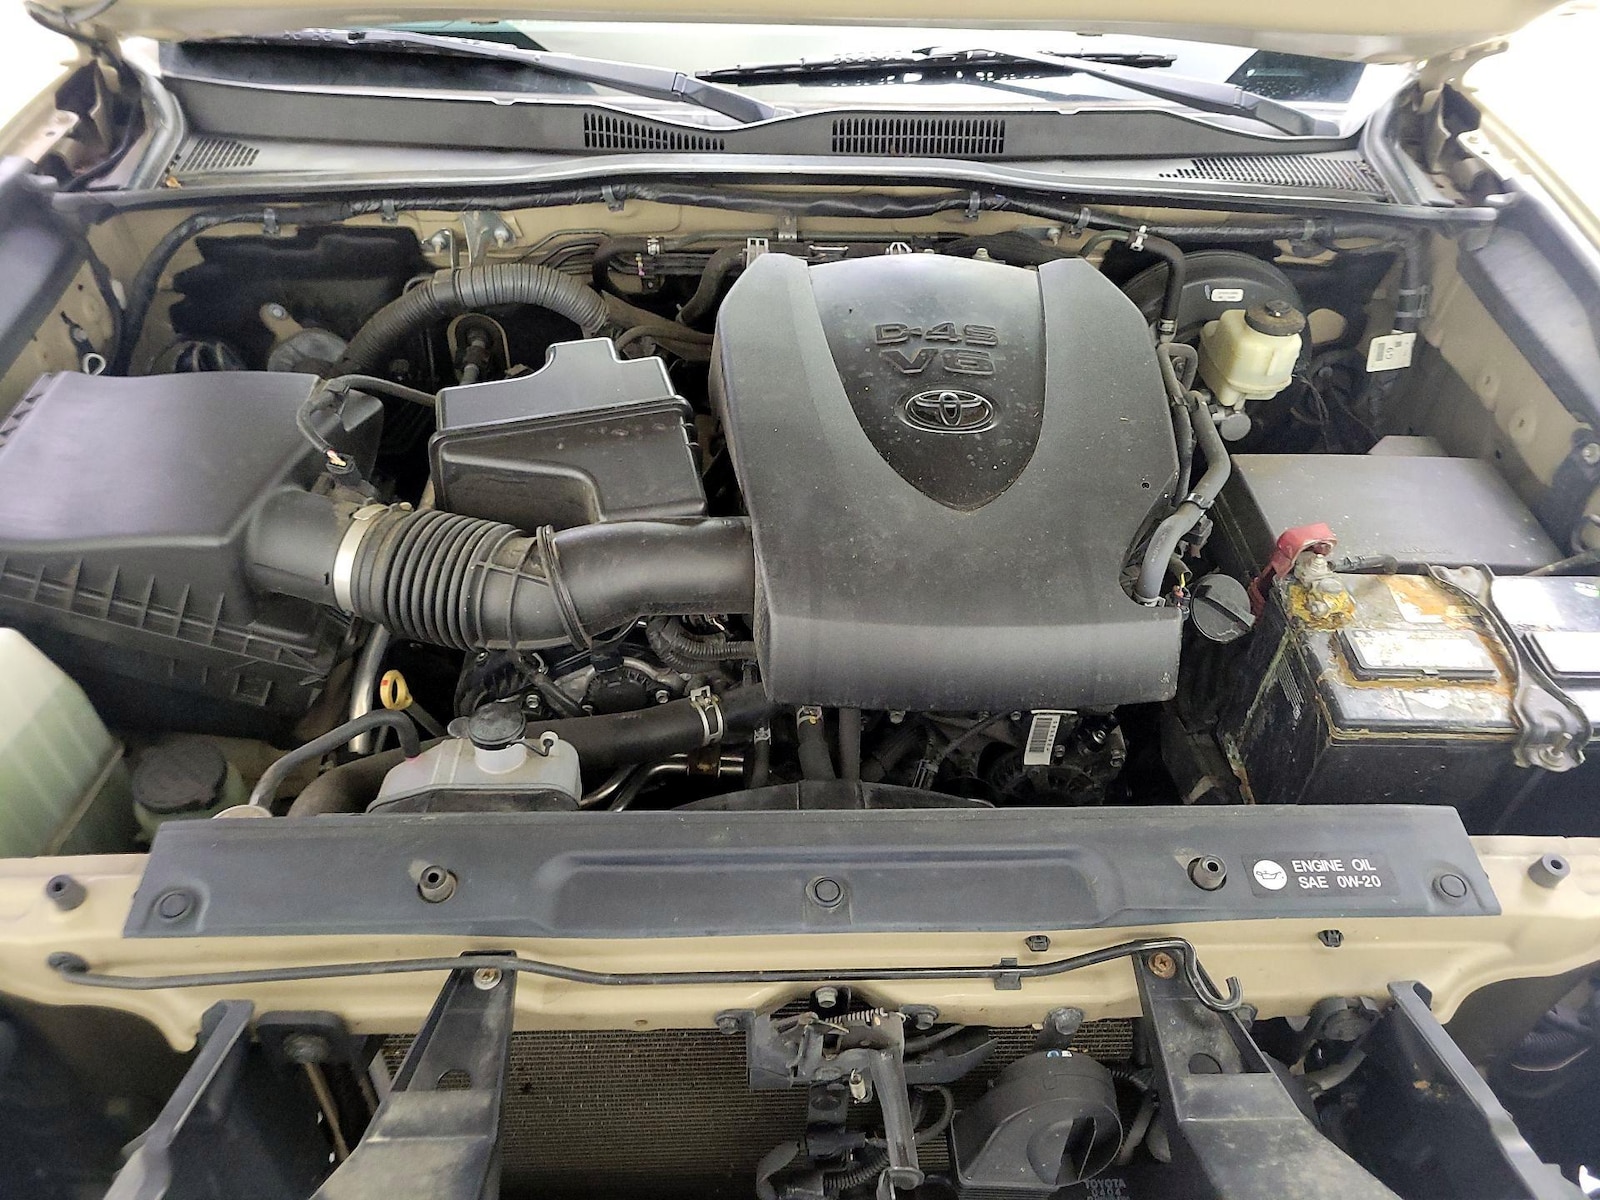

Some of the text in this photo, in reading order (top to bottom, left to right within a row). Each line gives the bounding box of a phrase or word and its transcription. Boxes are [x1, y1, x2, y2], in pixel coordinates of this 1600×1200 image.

[875, 321, 998, 346] D-4S
[880, 347, 996, 376] V6
[1291, 858, 1377, 873] ENGINE OIL
[1298, 875, 1382, 889] SAE 0W-20
[1084, 1178, 1127, 1189] TOYOTA
